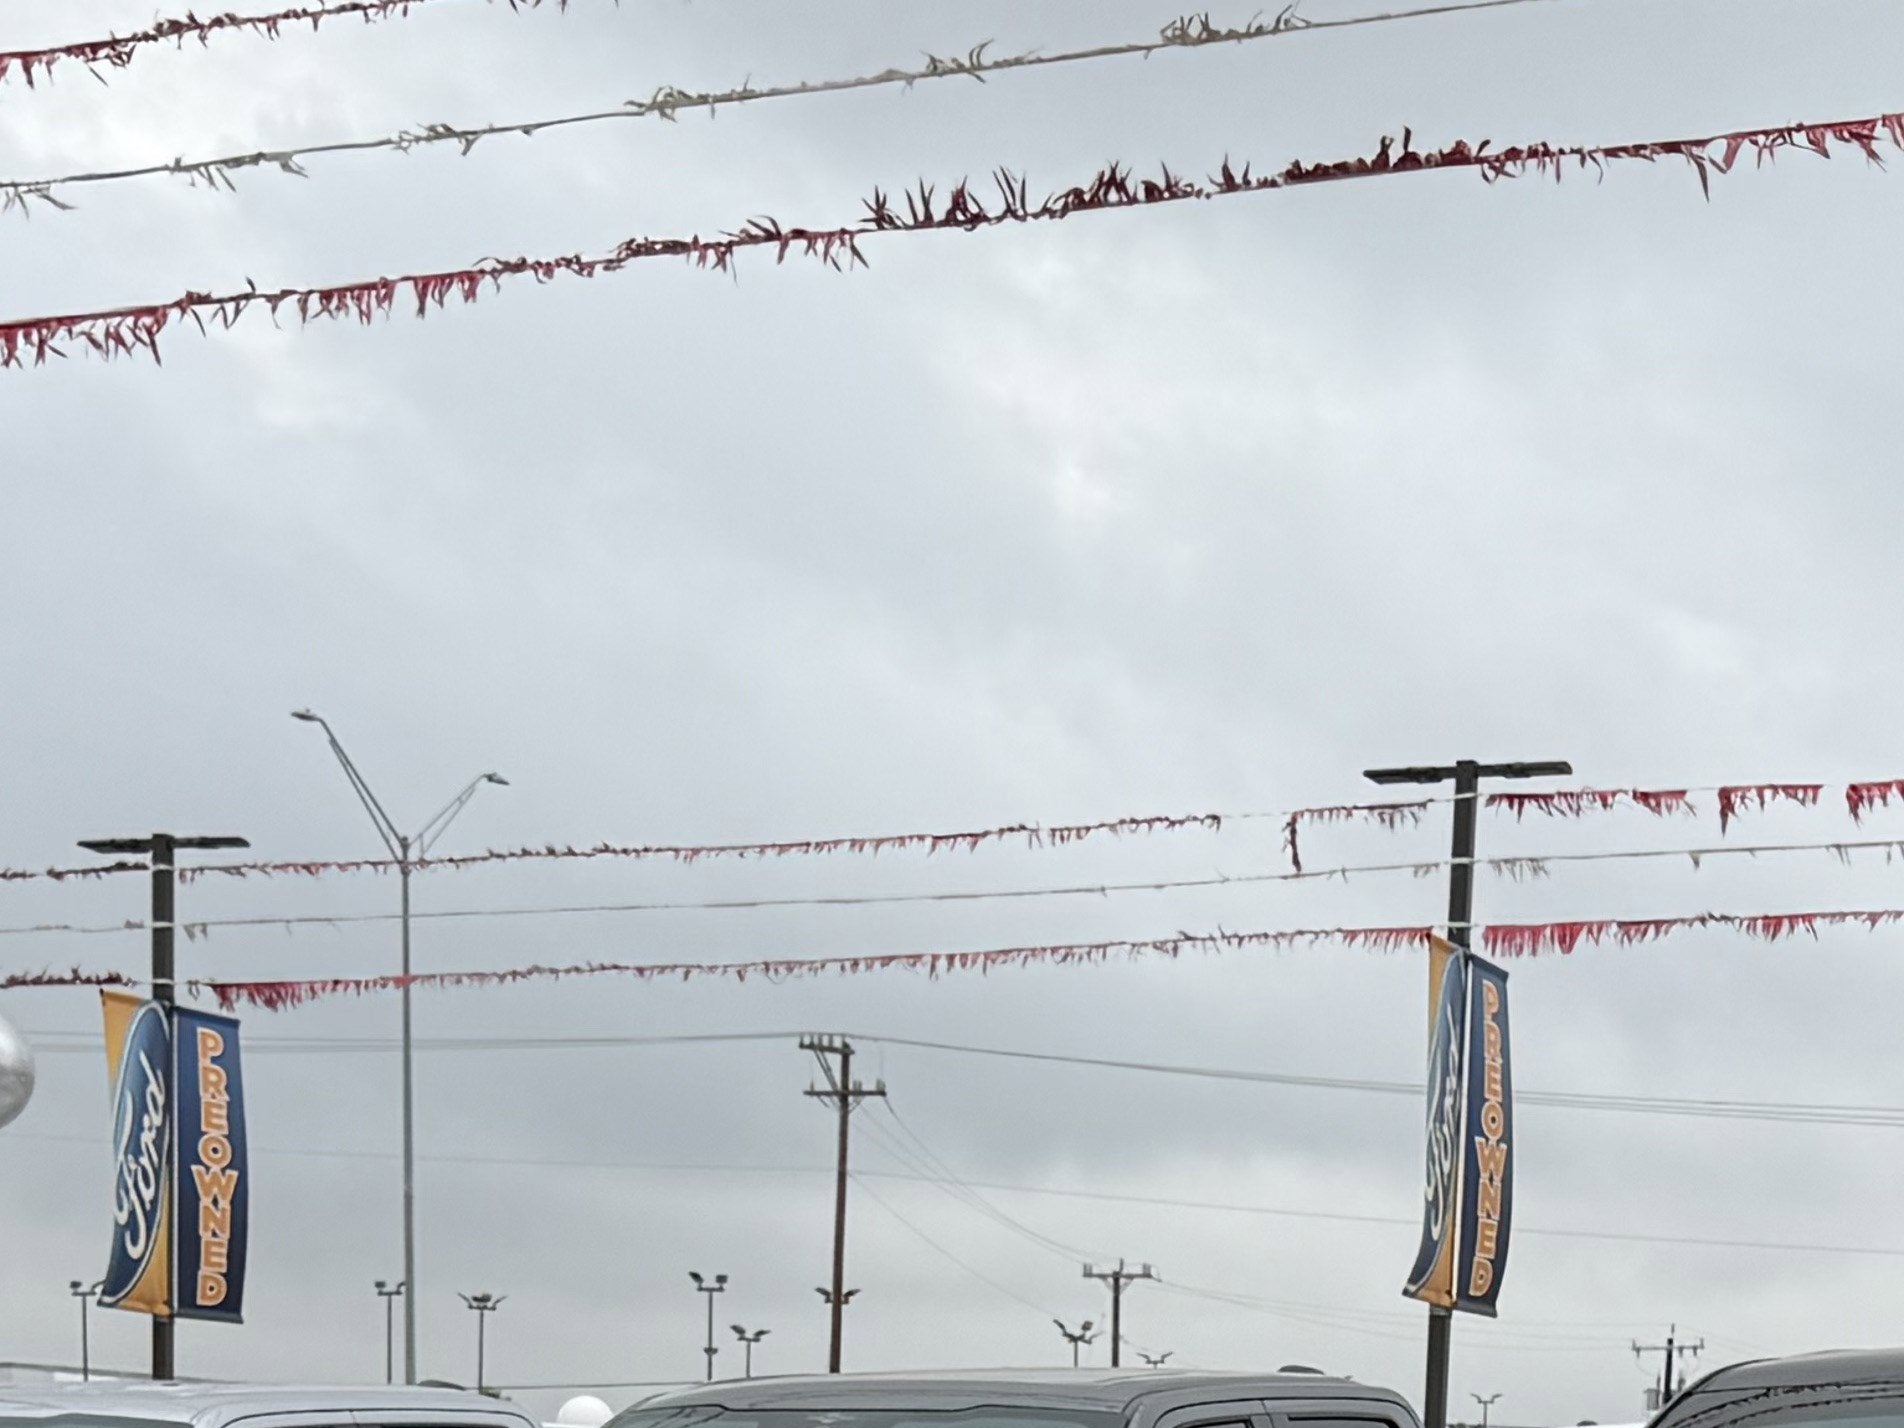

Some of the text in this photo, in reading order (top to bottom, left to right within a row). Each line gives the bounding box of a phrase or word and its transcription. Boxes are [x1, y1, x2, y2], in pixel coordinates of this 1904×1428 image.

[114, 1050, 167, 1262] Ford
[191, 1026, 238, 1308] PREOWNED
[1469, 979, 1507, 1297] PREOWNED
